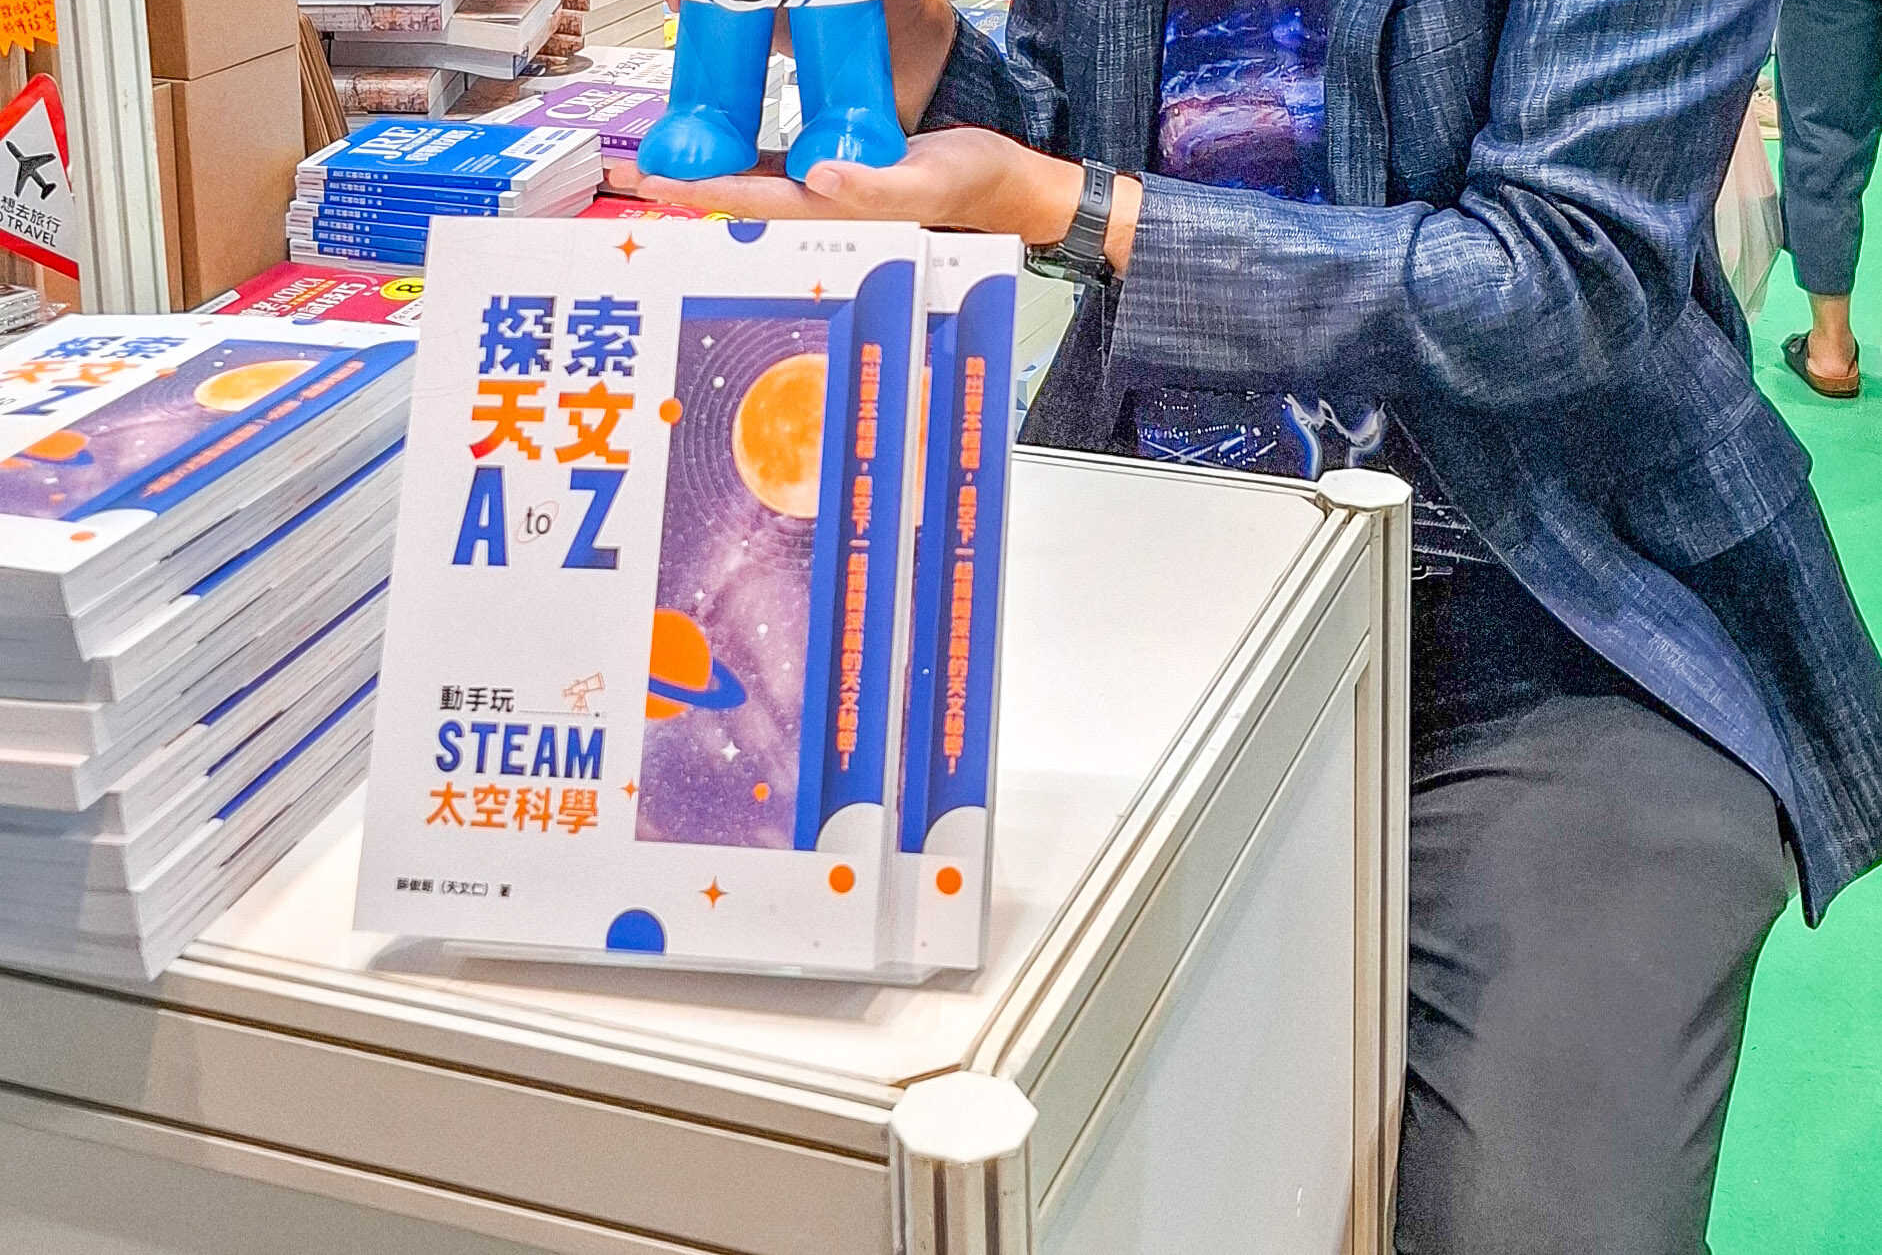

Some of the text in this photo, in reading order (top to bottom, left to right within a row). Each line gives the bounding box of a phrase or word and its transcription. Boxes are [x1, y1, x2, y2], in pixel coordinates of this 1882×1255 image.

[7, 214, 57, 248] TRAVEL
[478, 295, 643, 378] 探索
[469, 379, 636, 465] 天文
[452, 465, 629, 570] A to Z
[440, 684, 516, 713] 動手玩
[435, 719, 606, 781] STEAM
[425, 781, 599, 834] 太空科學
